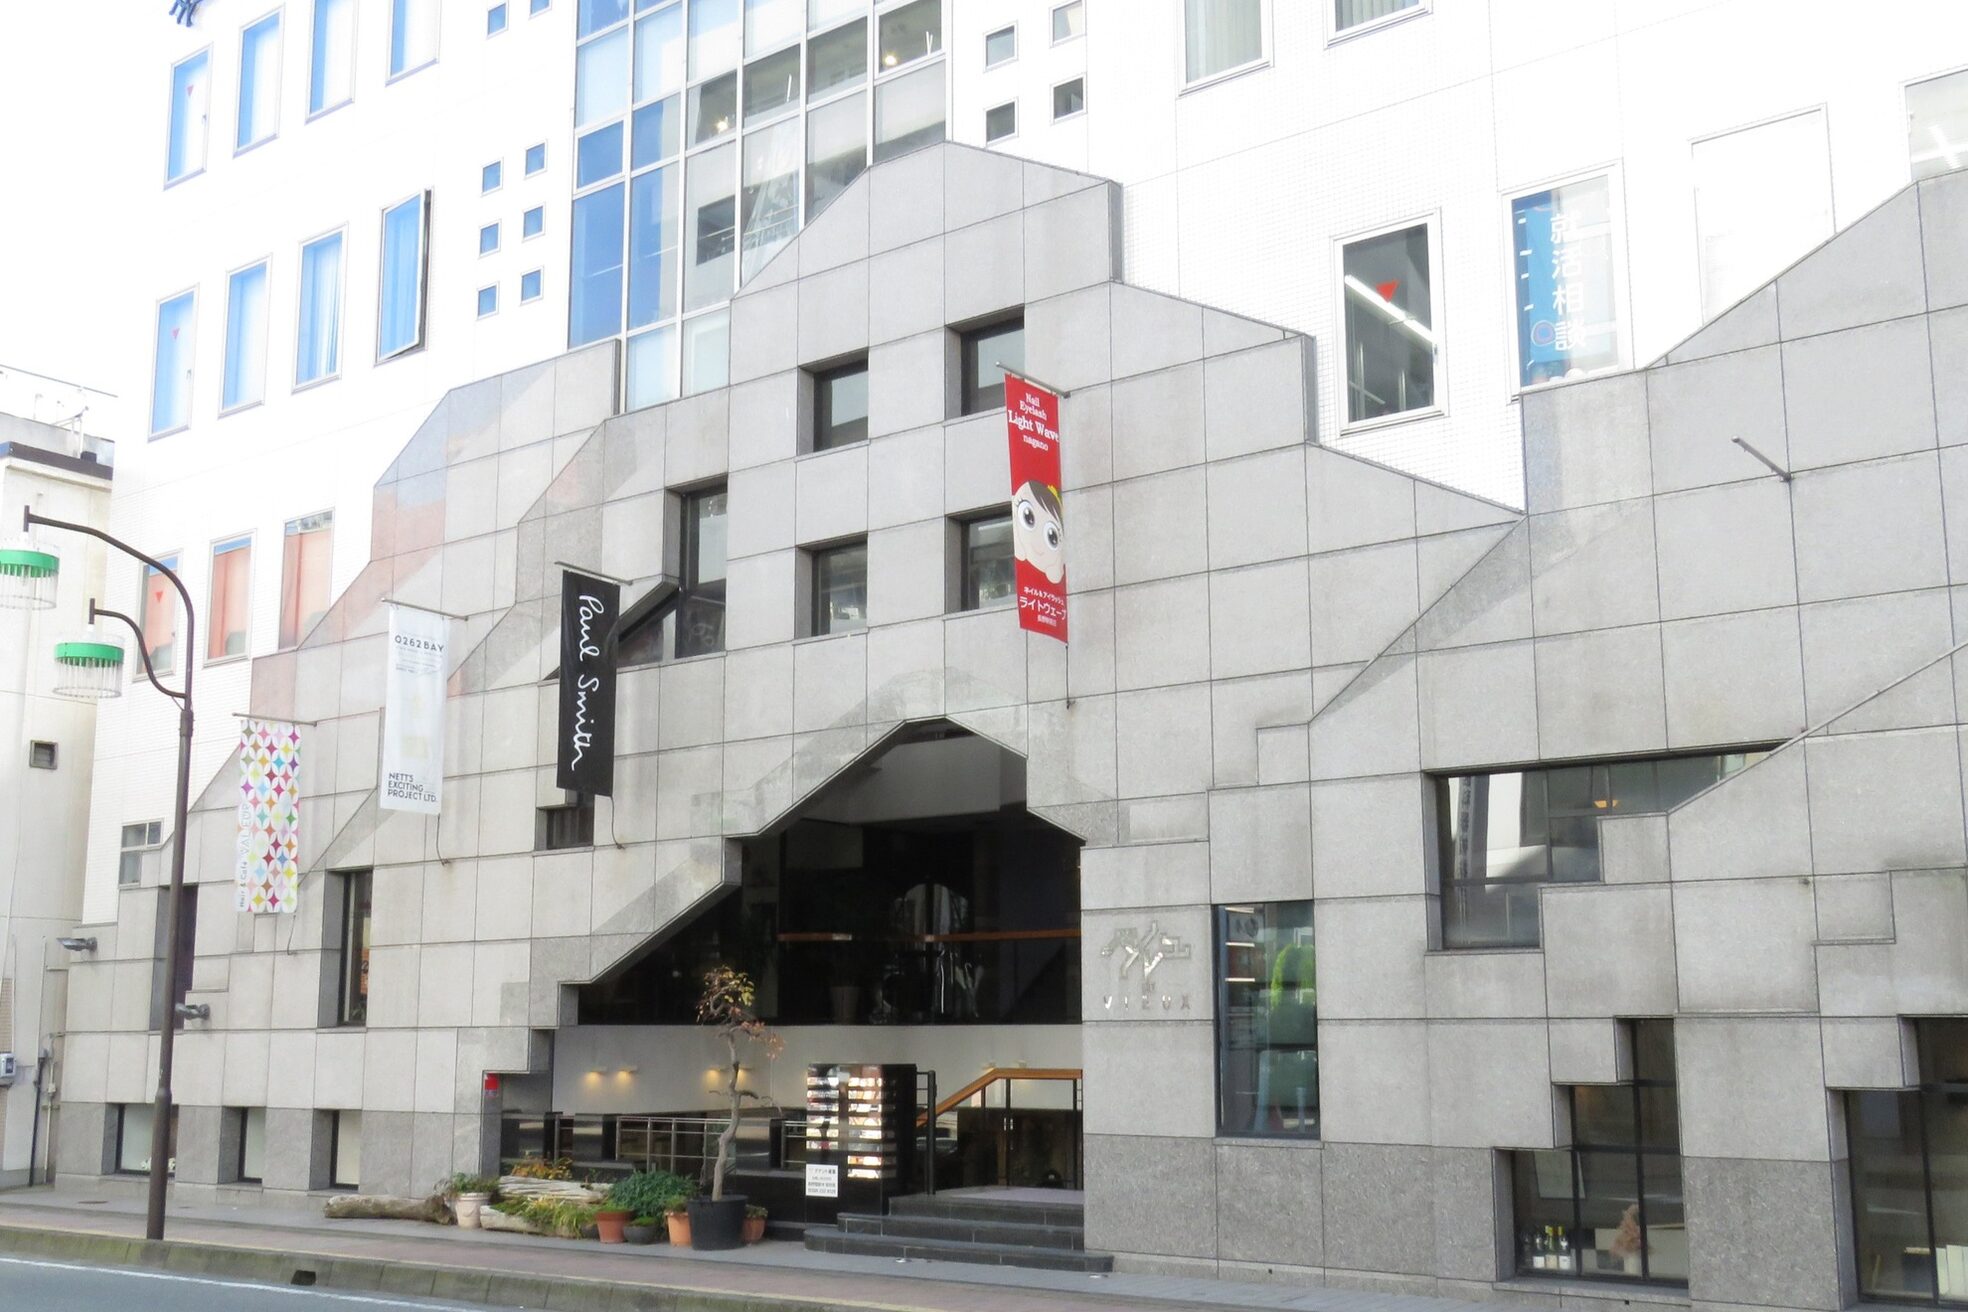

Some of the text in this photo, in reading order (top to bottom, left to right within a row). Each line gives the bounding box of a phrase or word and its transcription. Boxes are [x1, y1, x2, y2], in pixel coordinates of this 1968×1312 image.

[1025, 393, 1040, 408] Nail
[1019, 400, 1048, 421] Eyelash
[1008, 410, 1034, 431] Light
[1022, 435, 1049, 451] nagano
[578, 594, 605, 662] Paul
[571, 674, 600, 772] Smith
[387, 789, 422, 801] PROJECT
[388, 780, 424, 793] EXCITING
